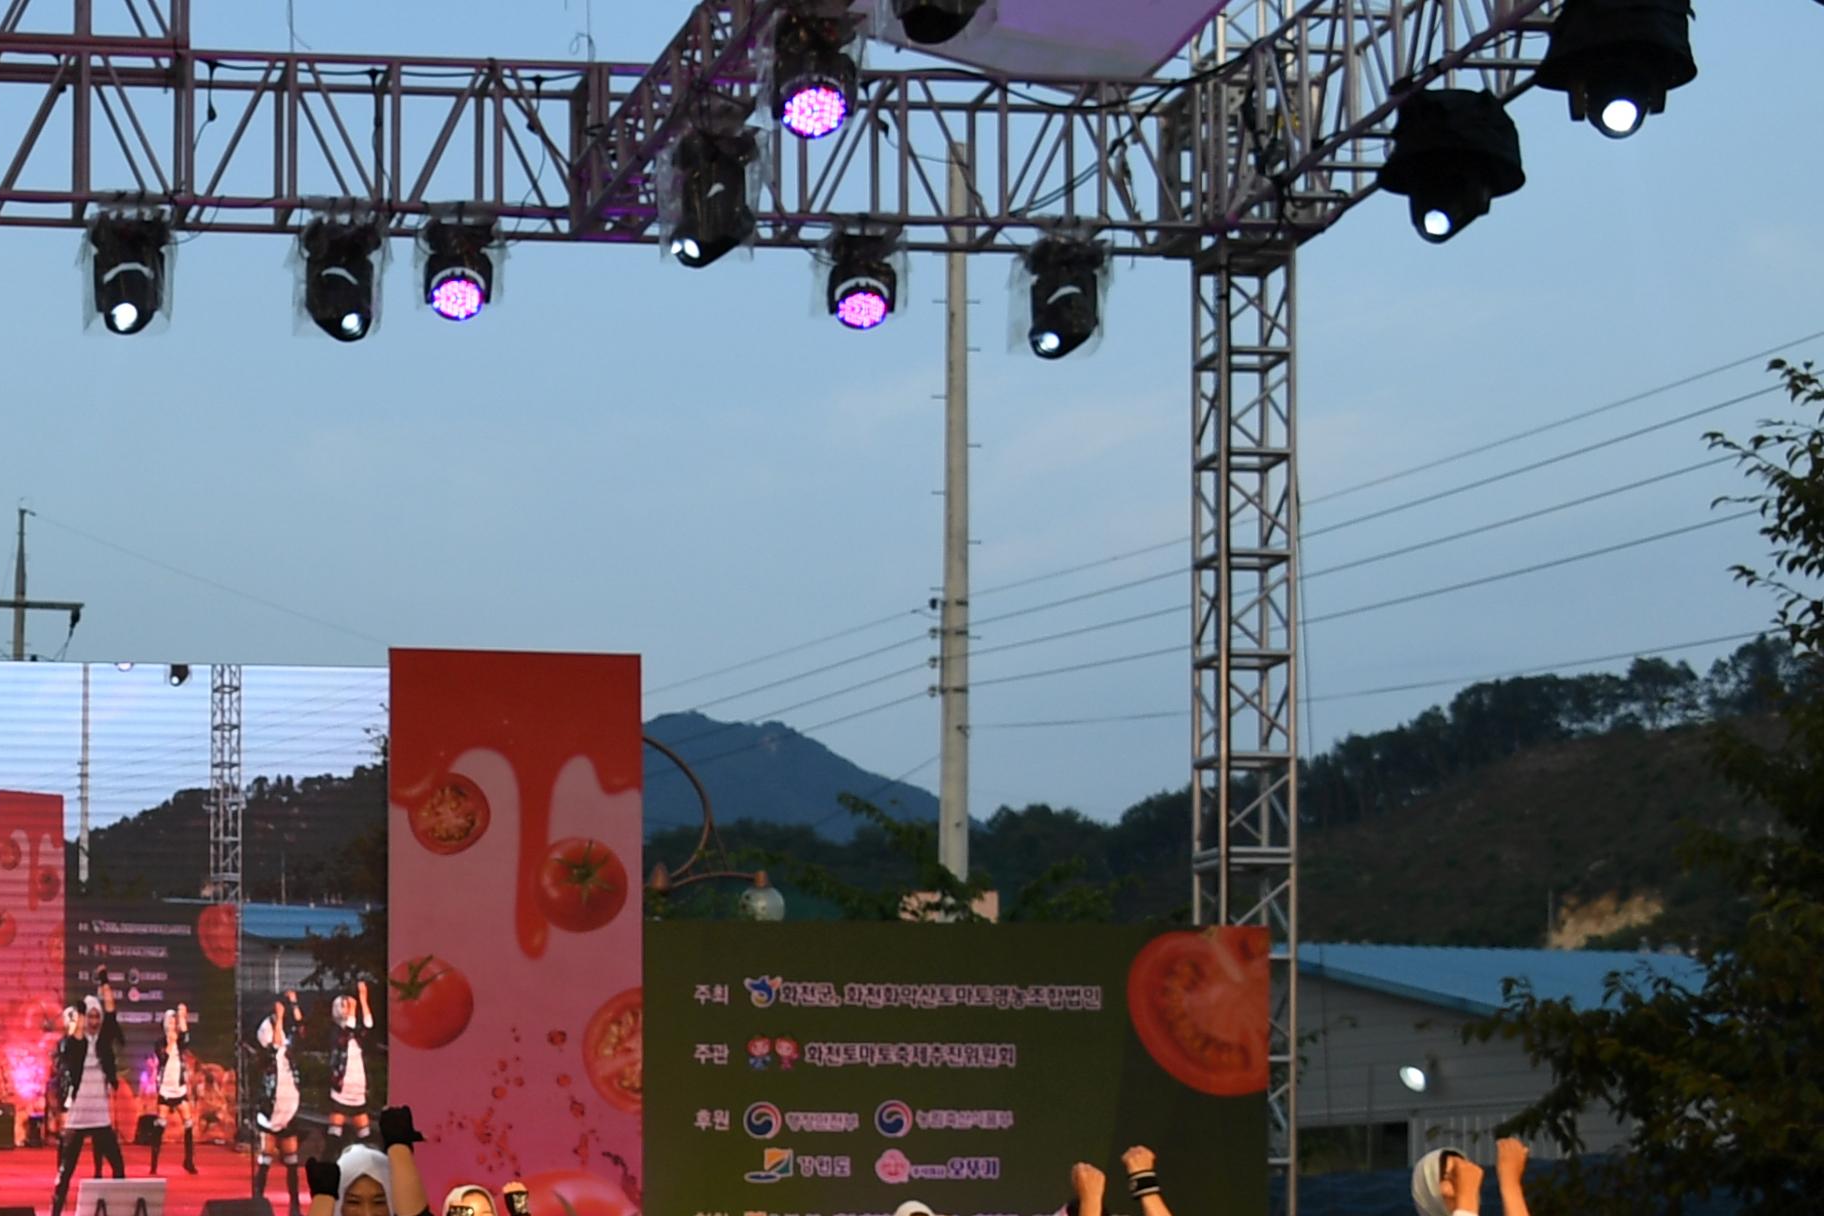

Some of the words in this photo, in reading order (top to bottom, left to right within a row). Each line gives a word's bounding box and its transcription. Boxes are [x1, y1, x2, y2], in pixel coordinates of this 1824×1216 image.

[694, 984, 729, 1005] 주최
[694, 1043, 729, 1065] 주관
[804, 1042, 1016, 1068] 화천토마토축제추진위원회
[694, 1110, 730, 1131] 후원
